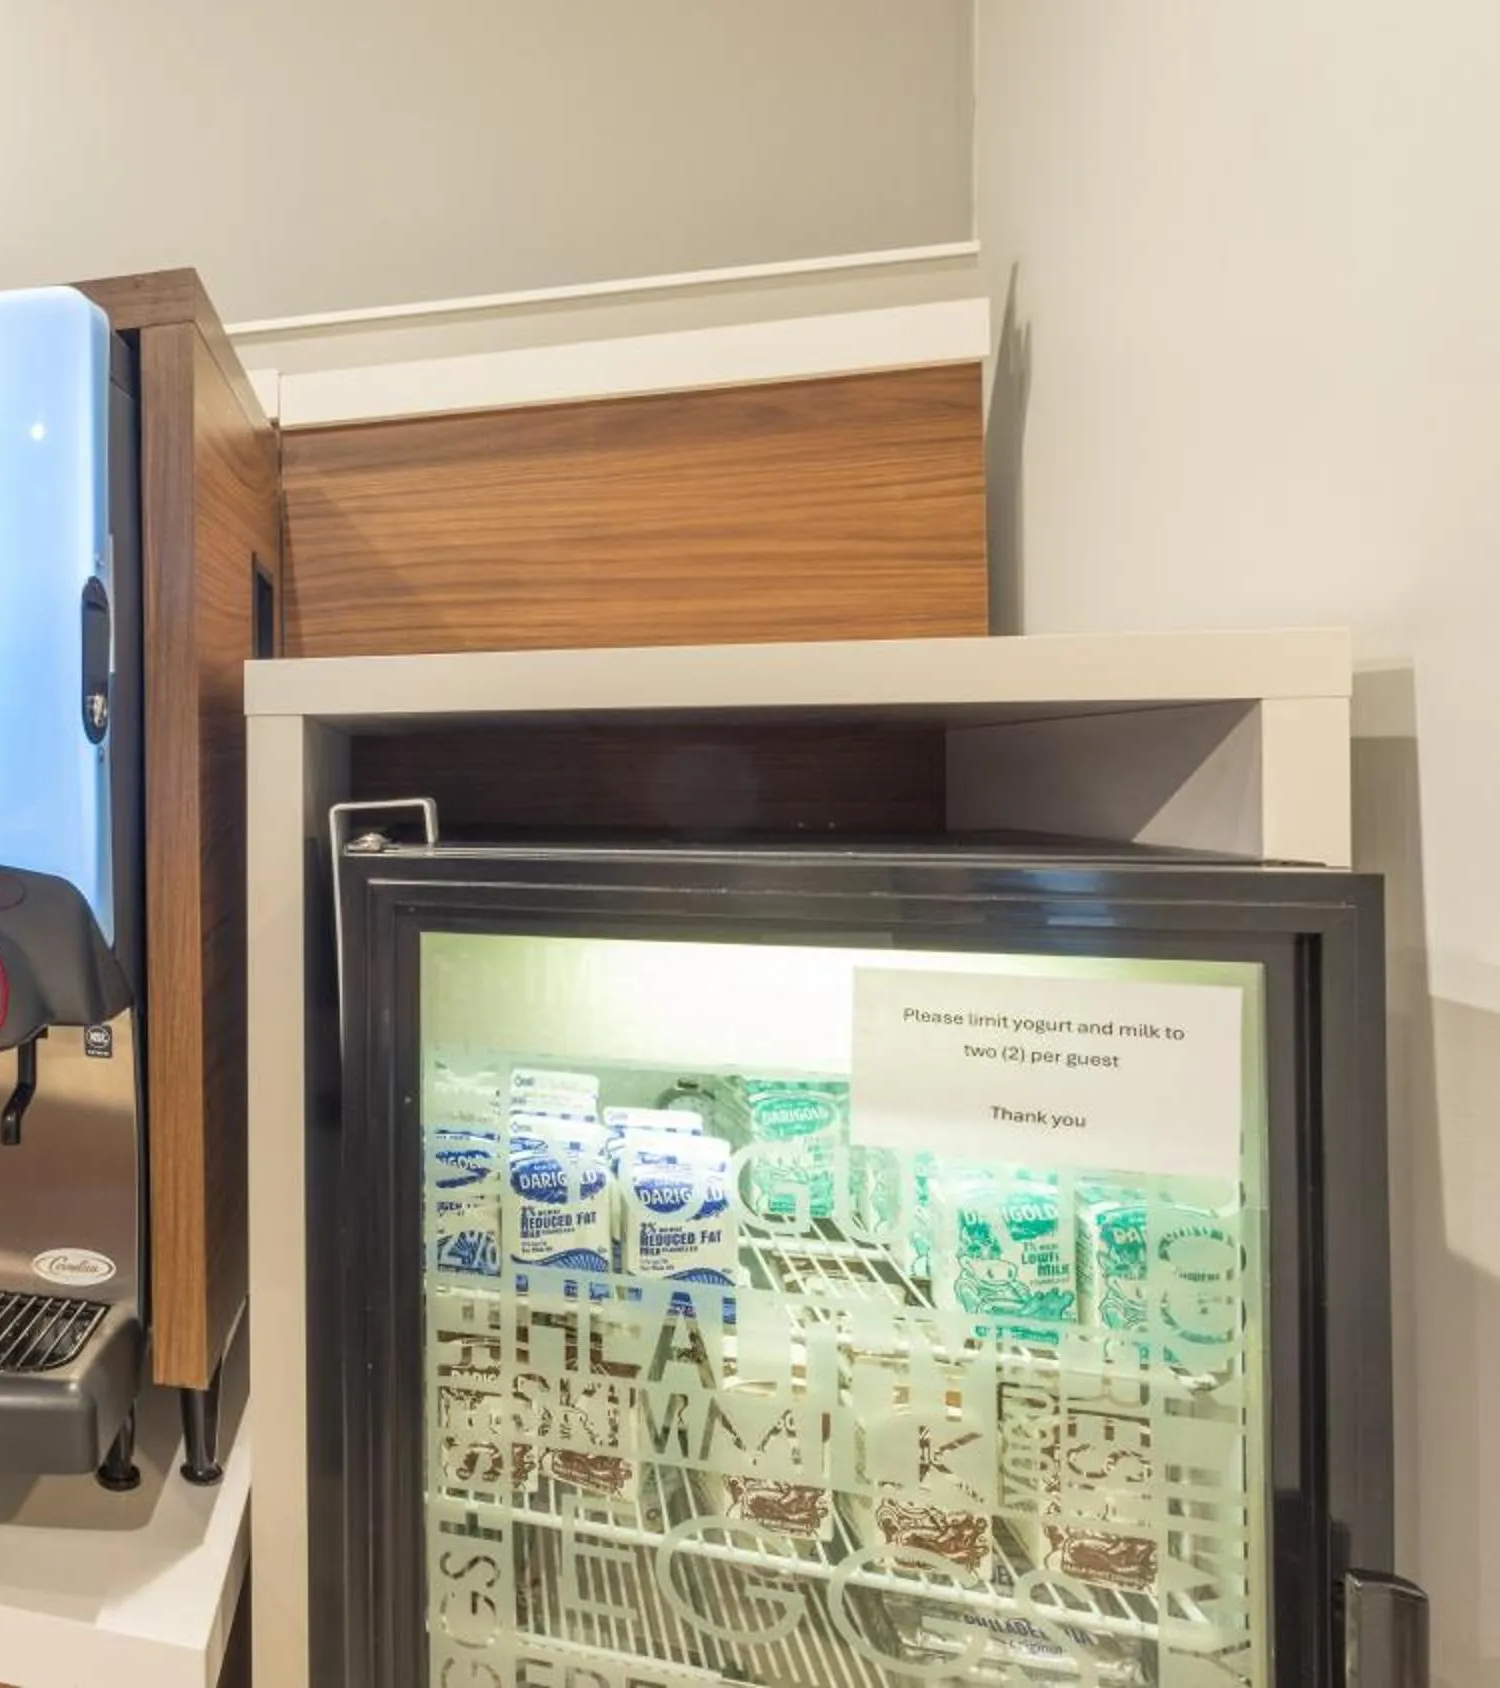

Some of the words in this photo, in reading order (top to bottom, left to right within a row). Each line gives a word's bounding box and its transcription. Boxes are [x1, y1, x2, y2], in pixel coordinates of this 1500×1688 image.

[903, 1007, 964, 1026] Please
[968, 1012, 1008, 1031] limit
[1012, 1017, 1073, 1037] yogurt
[1077, 1020, 1114, 1037] and
[1119, 1022, 1161, 1040] milk
[1165, 1026, 1185, 1042] to
[964, 1044, 997, 1060] two
[1001, 1046, 1026, 1064] (2)
[1030, 1050, 1061, 1066] per
[1066, 1054, 1120, 1071] guest
[990, 1106, 1048, 1126] Thank
[1052, 1112, 1087, 1130] you
[521, 1214, 573, 1230] REDUCED
[576, 1211, 598, 1225] FAT
[640, 1231, 696, 1247] REDUCED
[700, 1229, 722, 1244] FAT
